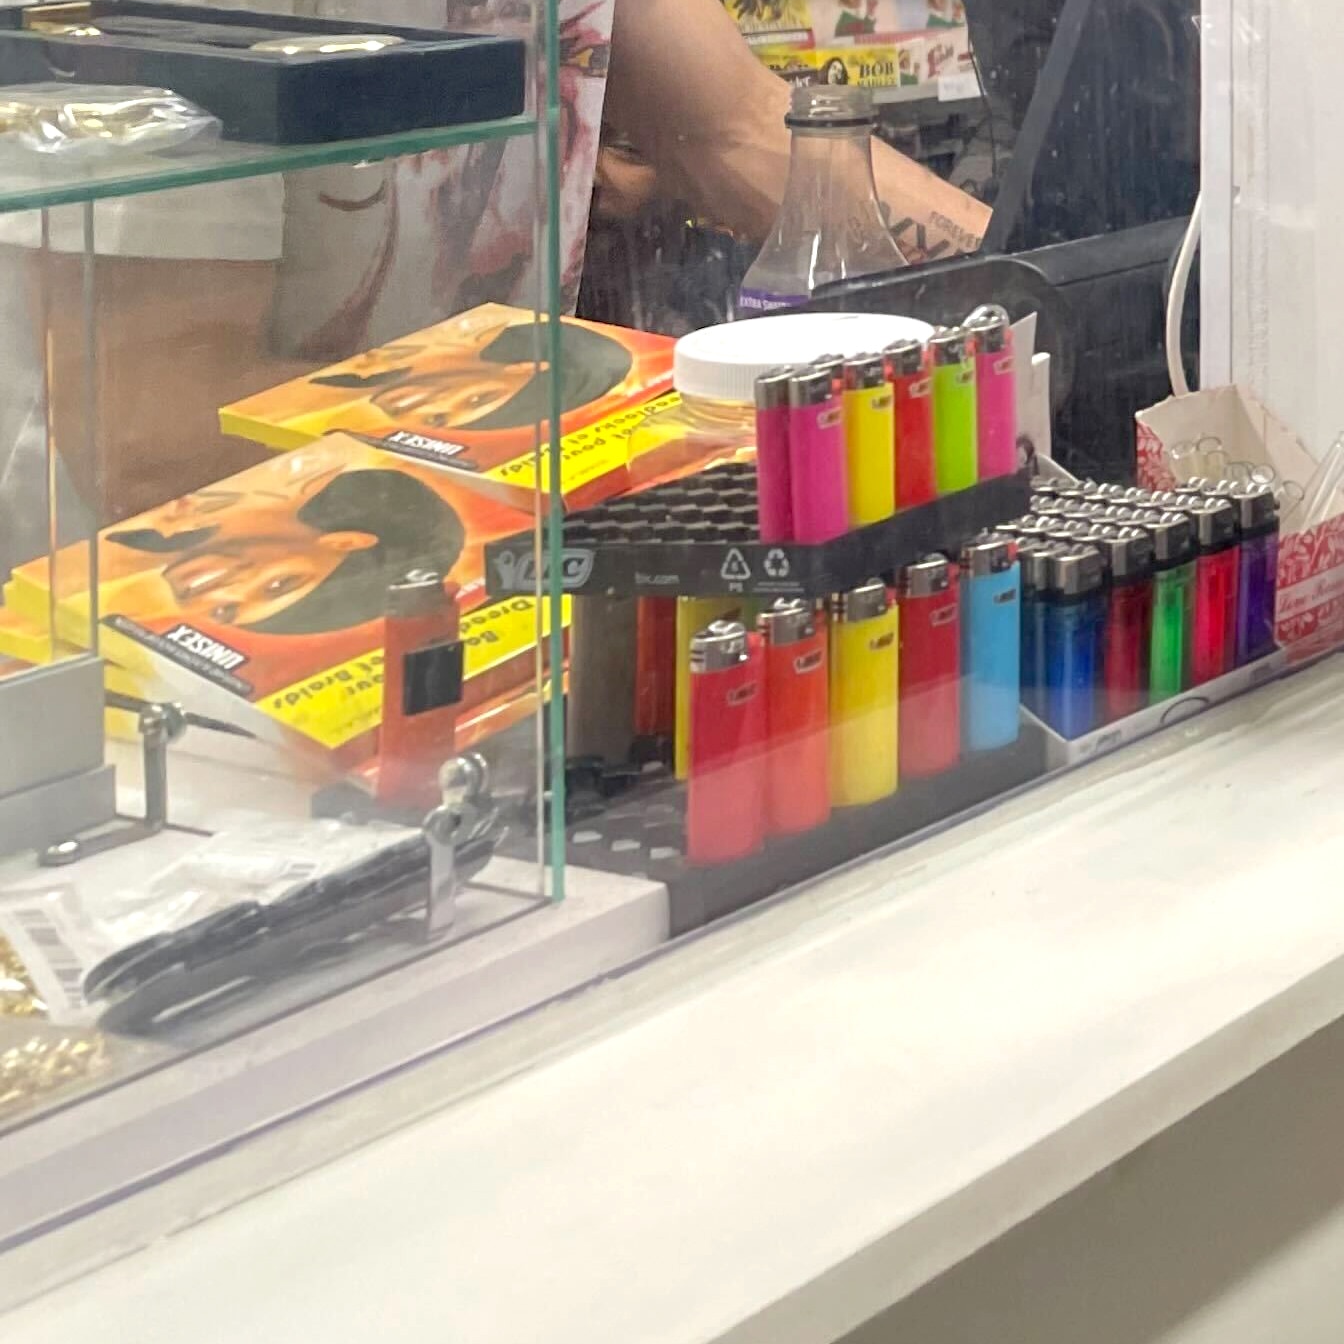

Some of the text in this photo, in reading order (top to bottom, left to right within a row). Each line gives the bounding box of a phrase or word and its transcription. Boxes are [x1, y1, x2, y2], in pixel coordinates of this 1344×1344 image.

[859, 62, 895, 77] BOB
[386, 430, 466, 456] UNISEX
[168, 624, 247, 671] UNISEX
